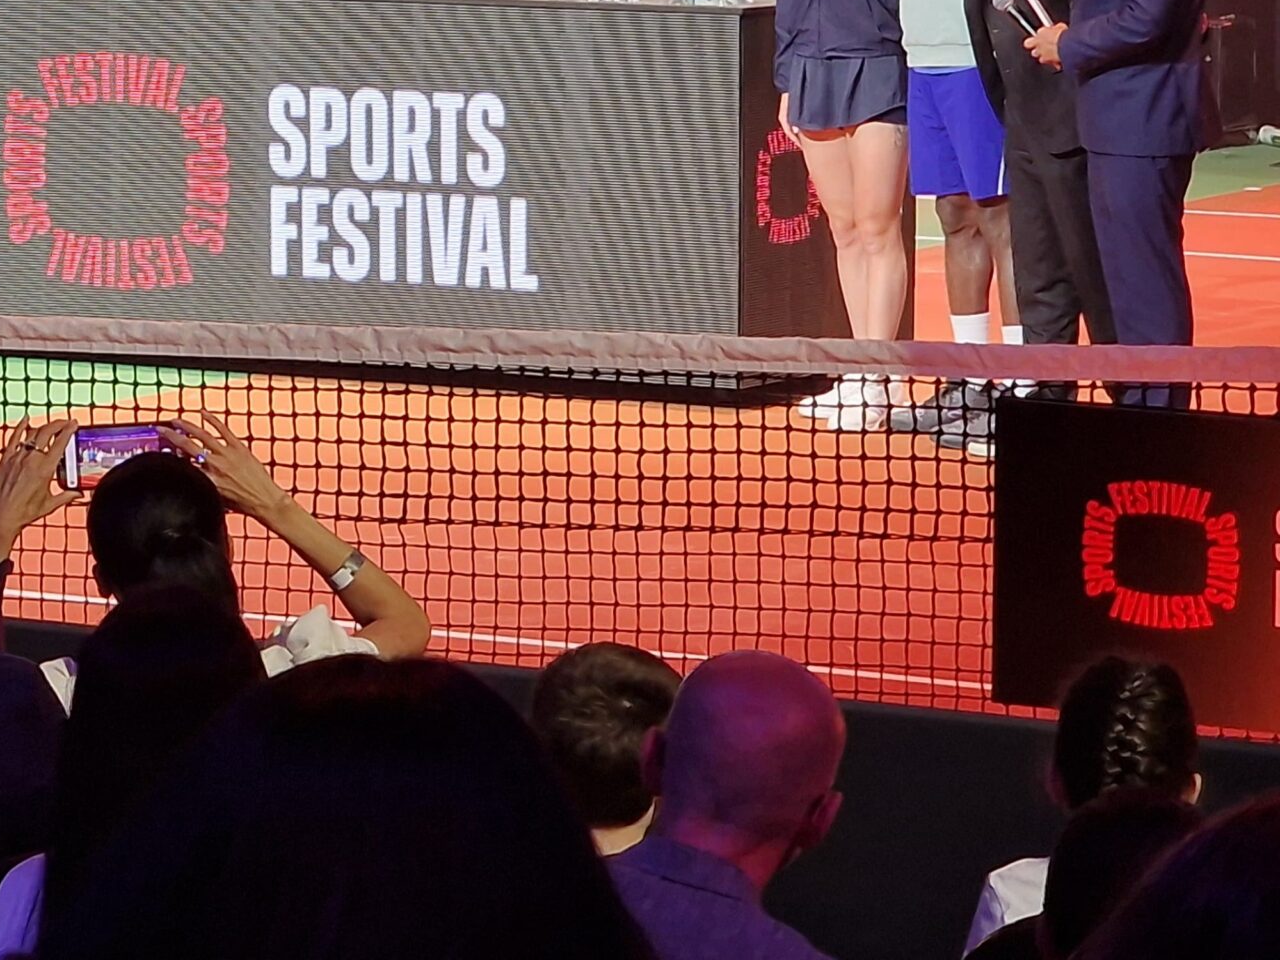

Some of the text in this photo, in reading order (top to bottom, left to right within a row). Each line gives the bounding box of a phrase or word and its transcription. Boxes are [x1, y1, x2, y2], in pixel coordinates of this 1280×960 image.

[38, 50, 186, 112] FESTIVAL
[3, 89, 51, 243] SPORTS
[180, 97, 230, 254] SPORTS
[268, 83, 506, 188] SPORTS
[46, 228, 194, 290] FESTIVAL
[270, 184, 539, 291] FESTIVAL
[1082, 500, 1116, 596] SPORTS
[1108, 481, 1211, 522] FESTIVAL
[1110, 587, 1213, 628] FESTIVAL
[1205, 513, 1239, 610] SPORTS
